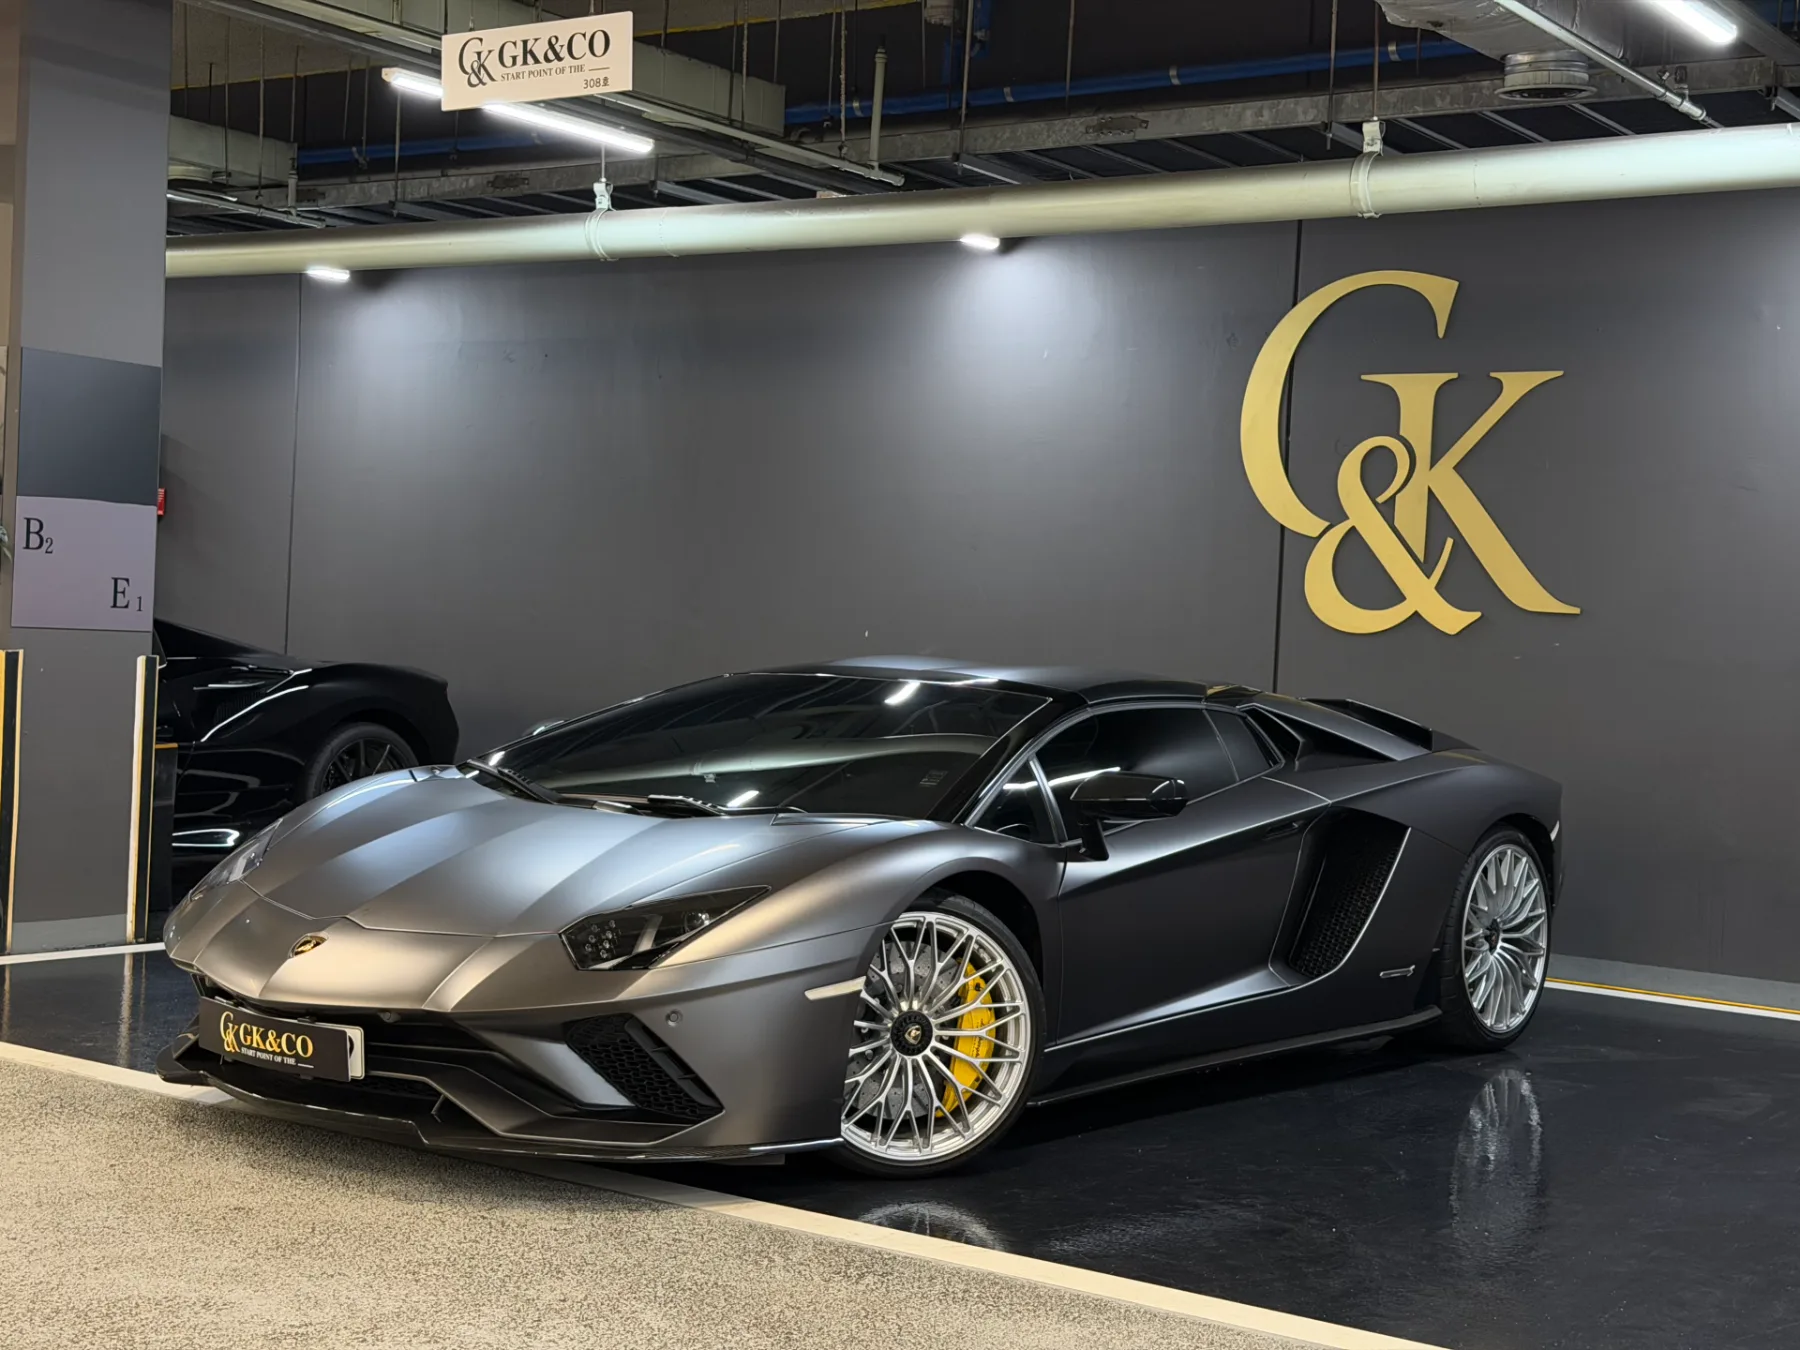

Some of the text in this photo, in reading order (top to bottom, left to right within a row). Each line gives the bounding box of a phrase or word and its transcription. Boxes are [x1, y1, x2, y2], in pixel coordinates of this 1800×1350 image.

[498, 29, 611, 68] GK&CO
[500, 64, 586, 82] START POINT OF THE
[583, 76, 610, 89] 308호
[240, 1023, 313, 1057] GK&CO
[241, 1047, 296, 1065] START POINT OF THE
